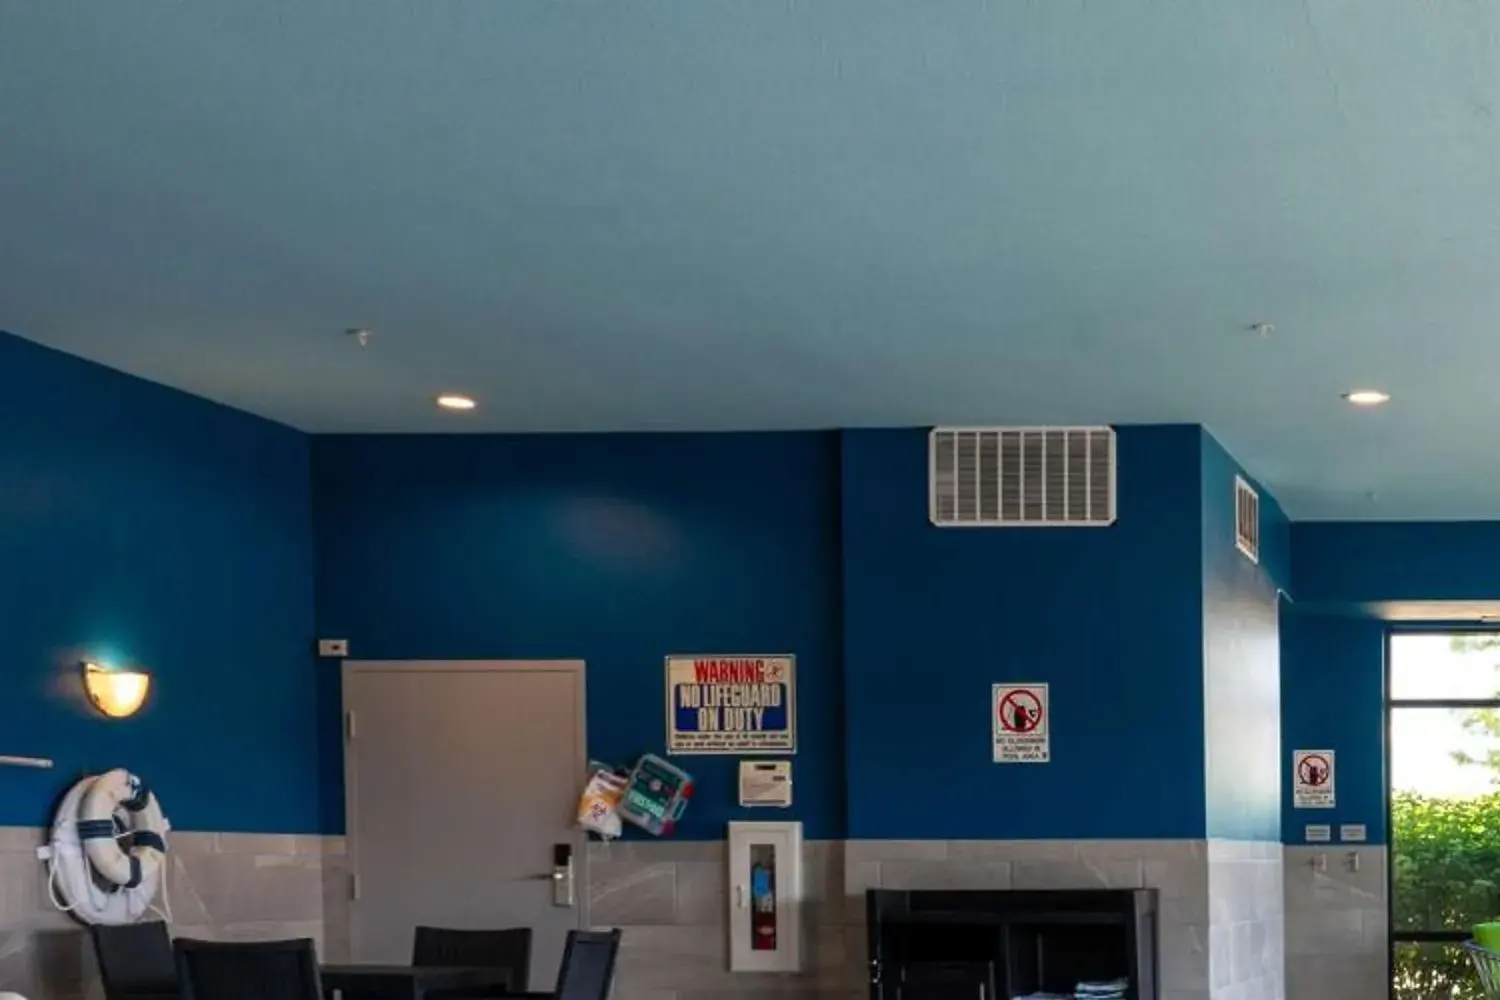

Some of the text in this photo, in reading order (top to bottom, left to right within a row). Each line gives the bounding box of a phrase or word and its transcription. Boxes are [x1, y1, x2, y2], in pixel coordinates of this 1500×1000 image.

[694, 659, 765, 683] WARNING
[681, 683, 781, 708] NO LIFEGUARD
[698, 707, 764, 731] ON DUTY
